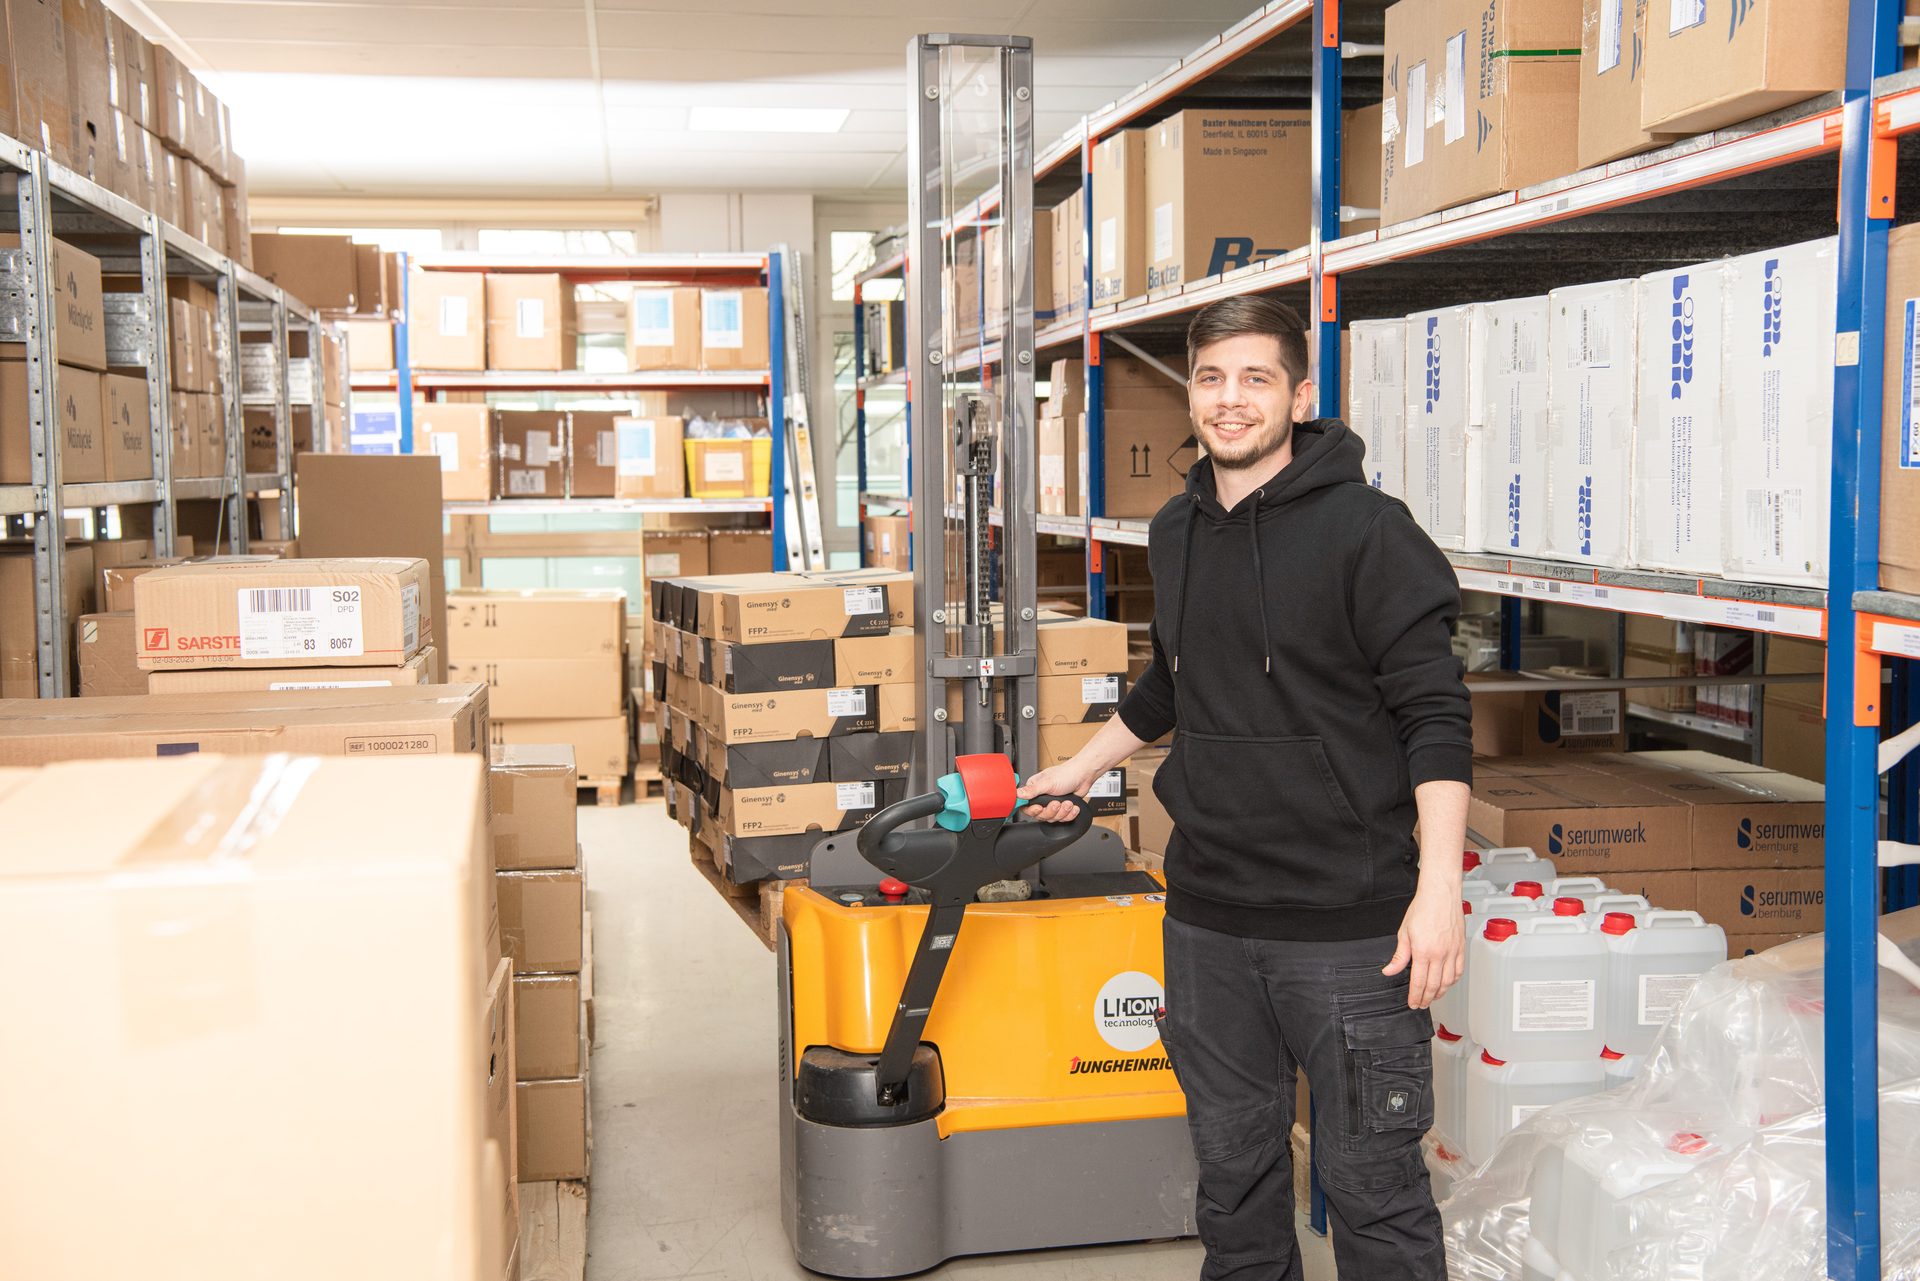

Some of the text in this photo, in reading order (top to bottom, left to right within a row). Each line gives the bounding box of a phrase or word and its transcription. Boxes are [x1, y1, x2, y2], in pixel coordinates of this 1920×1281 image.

[1488, 0, 1496, 21] CA
[1479, 10, 1489, 100] FRESENIUS
[1202, 118, 1312, 129] Baxter Healthcare Corporation
[1237, 130, 1244, 138] IL
[1271, 130, 1288, 138] USA
[1202, 147, 1268, 157] Made in Singapore
[1147, 264, 1181, 290] Baxter
[332, 590, 359, 603] S02
[337, 605, 355, 613] DPD
[746, 600, 779, 611] Ginensys
[748, 627, 768, 635] FFP2
[177, 635, 241, 651] SARSTE
[304, 637, 353, 651] 83 8067
[152, 654, 235, 665] 02-03-2023 11:03:06
[1054, 659, 1079, 668] Ginensys
[777, 674, 804, 684] Ginensys
[858, 669, 883, 679] Ginensys
[731, 700, 764, 711] Ginensys
[902, 715, 915, 723] Gine
[733, 728, 753, 737] FFP2
[350, 740, 429, 751] REF 1000021280
[874, 763, 900, 774] Ginensys
[773, 770, 799, 781] Ginensys
[740, 795, 773, 806] Ginensys
[742, 821, 762, 831] FFP2
[1755, 821, 1825, 840] serumwer
[1567, 821, 1647, 845] serumwerk
[1754, 839, 1800, 853] bernburg
[1566, 846, 1611, 859] bernburg
[777, 863, 804, 874] Ginensys
[1758, 887, 1825, 907] serumwe
[1758, 906, 1802, 920] bernburg
[1070, 1056, 1174, 1075] JUNGHEINRIC
